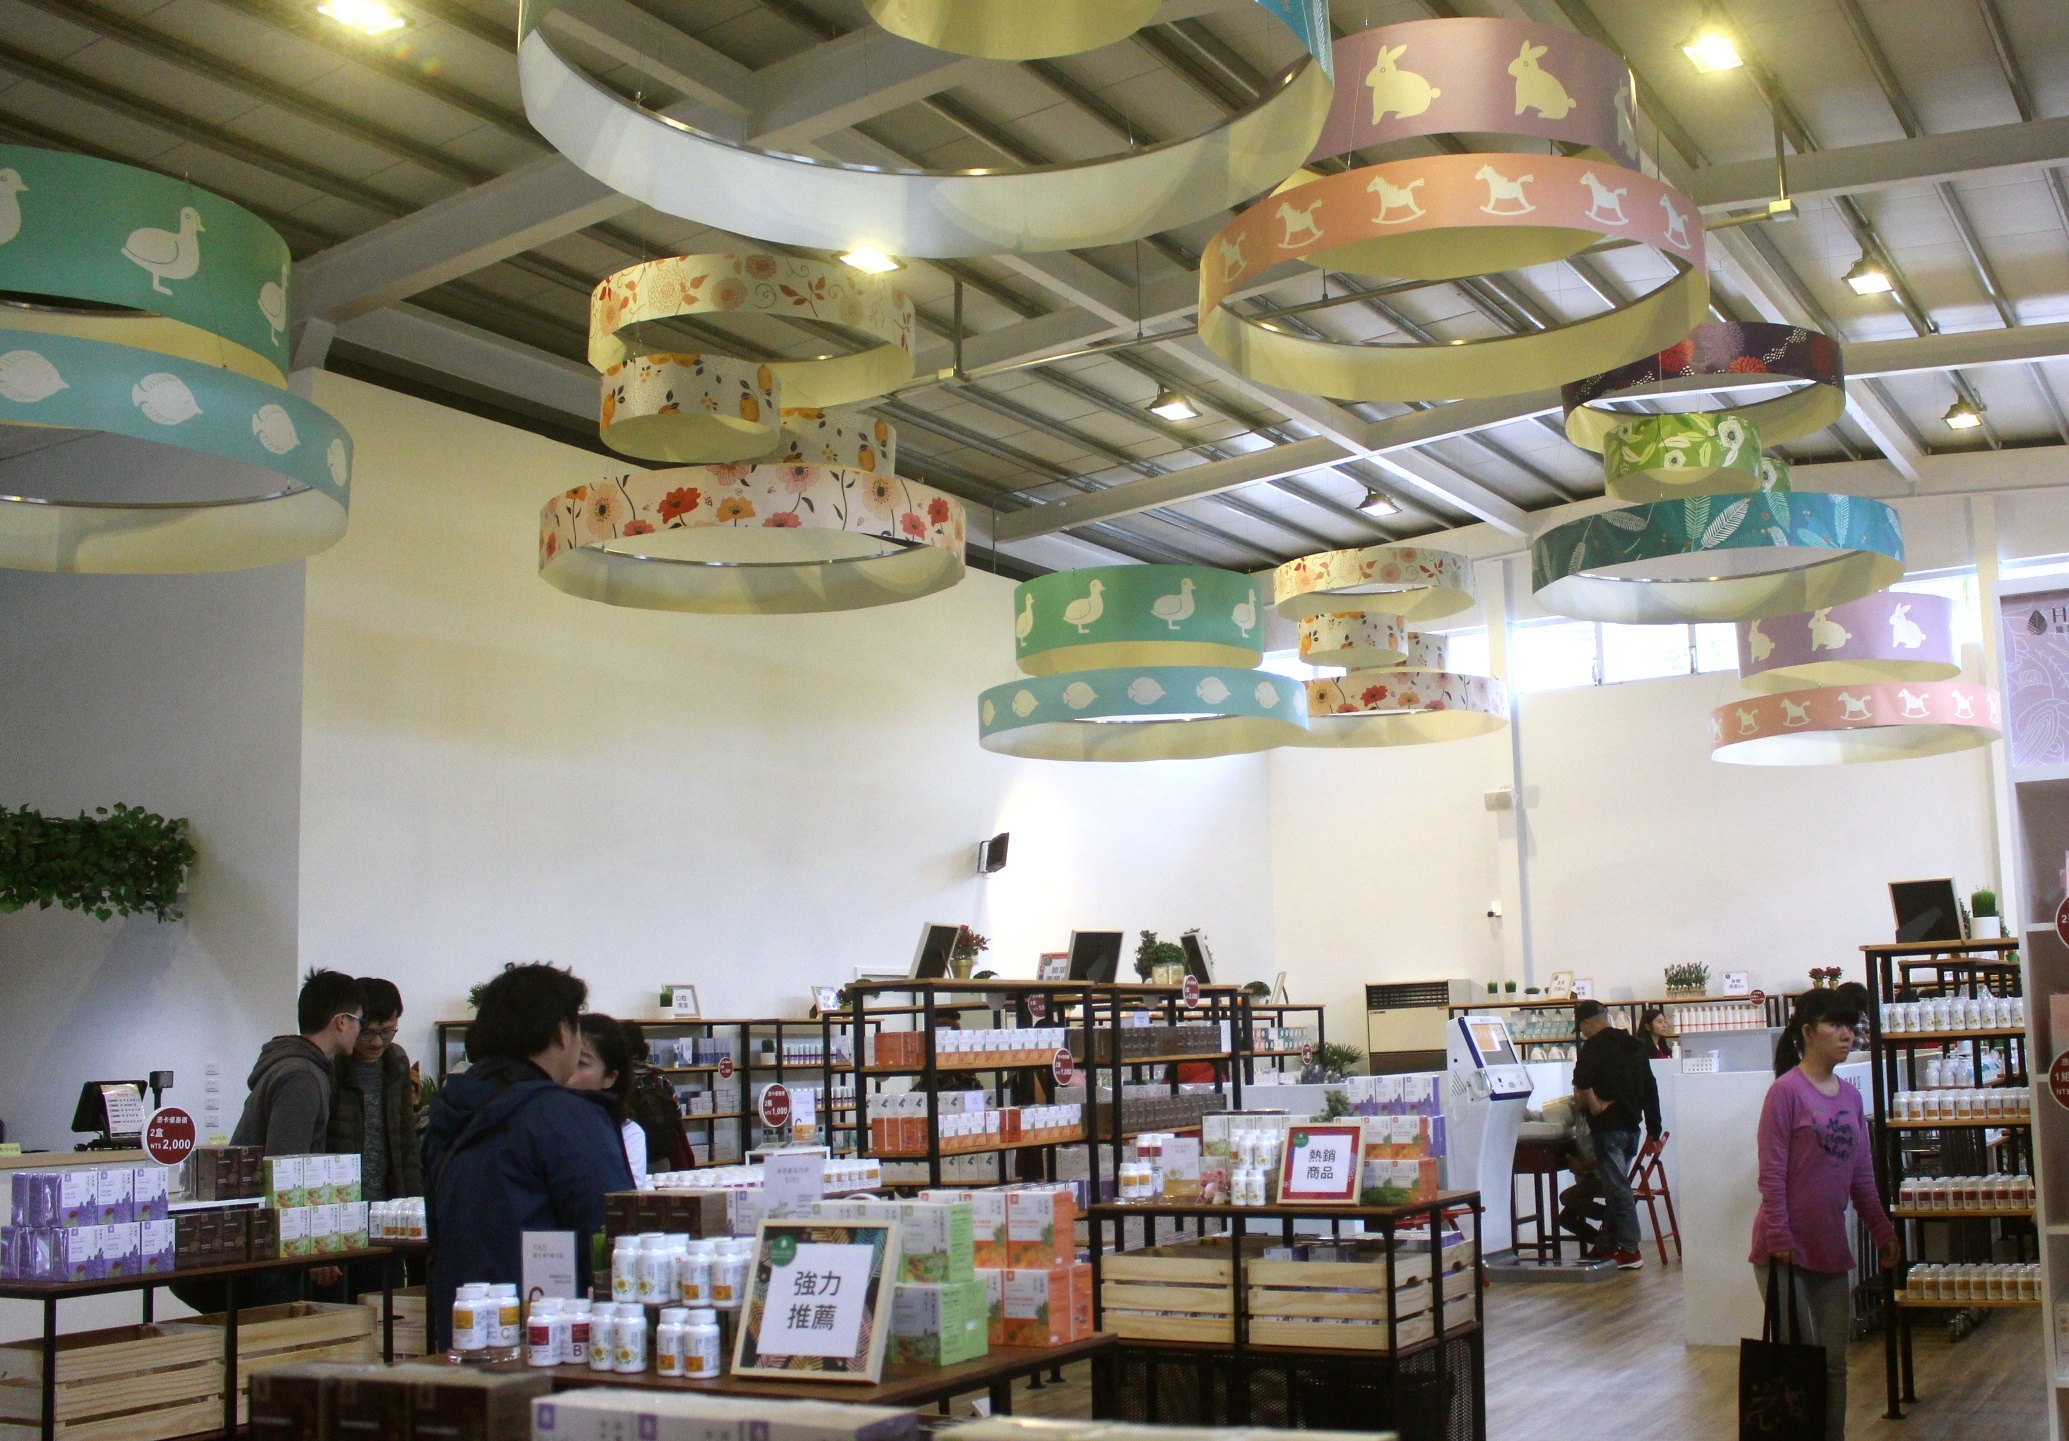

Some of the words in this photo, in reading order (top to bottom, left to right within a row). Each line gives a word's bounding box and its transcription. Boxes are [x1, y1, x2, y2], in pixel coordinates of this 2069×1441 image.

[772, 1105, 788, 1116] 1,000
[150, 1127, 164, 1138] 2盒
[162, 1139, 191, 1151] 2,000
[1308, 1149, 1336, 1162] 熱銷
[1306, 1166, 1334, 1180] 商品
[793, 1270, 842, 1297] 強力
[787, 1303, 837, 1331] 推薦
[501, 1327, 511, 1340] C
[573, 1344, 582, 1357] B
